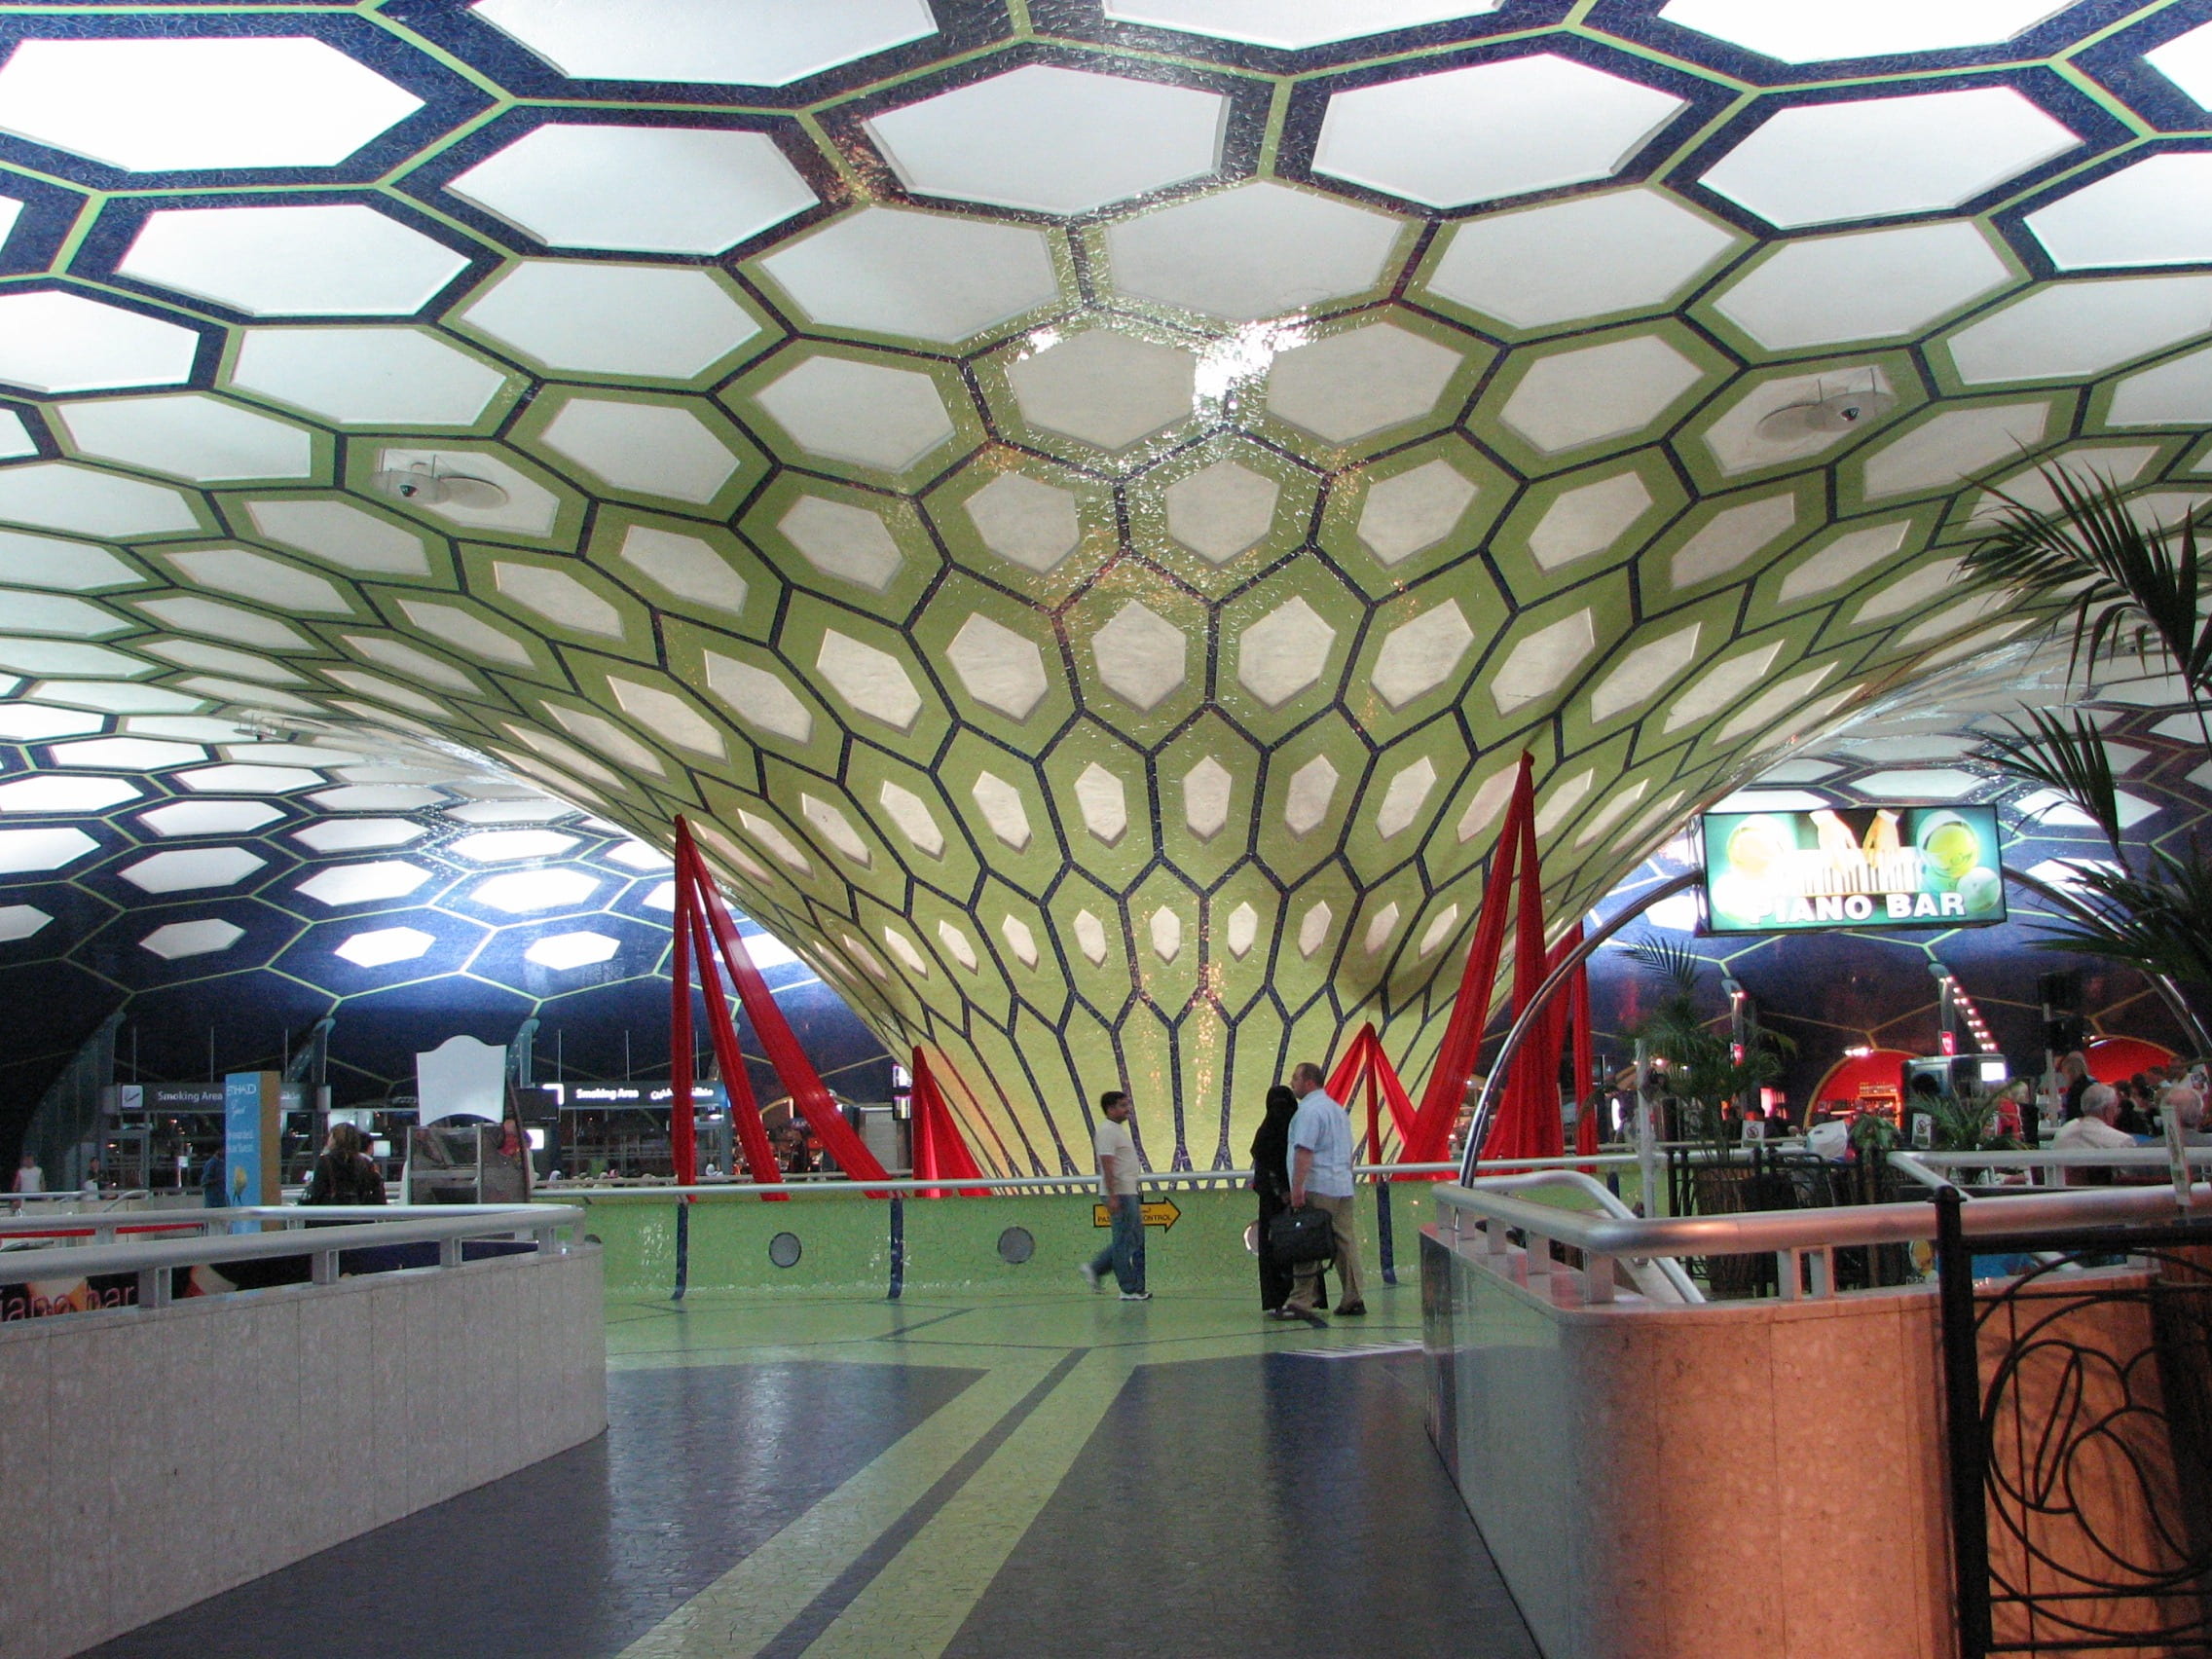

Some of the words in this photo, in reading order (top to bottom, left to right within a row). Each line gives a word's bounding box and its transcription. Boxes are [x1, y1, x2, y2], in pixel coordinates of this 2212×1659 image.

[1751, 894, 1873, 924] PIANO
[1885, 891, 1967, 919] BAR
[158, 1090, 200, 1102] Smoking
[202, 1091, 223, 1100] Area
[576, 1088, 616, 1100] Smoking
[617, 1088, 640, 1098] Area
[1143, 1214, 1171, 1223] ONTROL
[86, 1284, 135, 1310] bar
